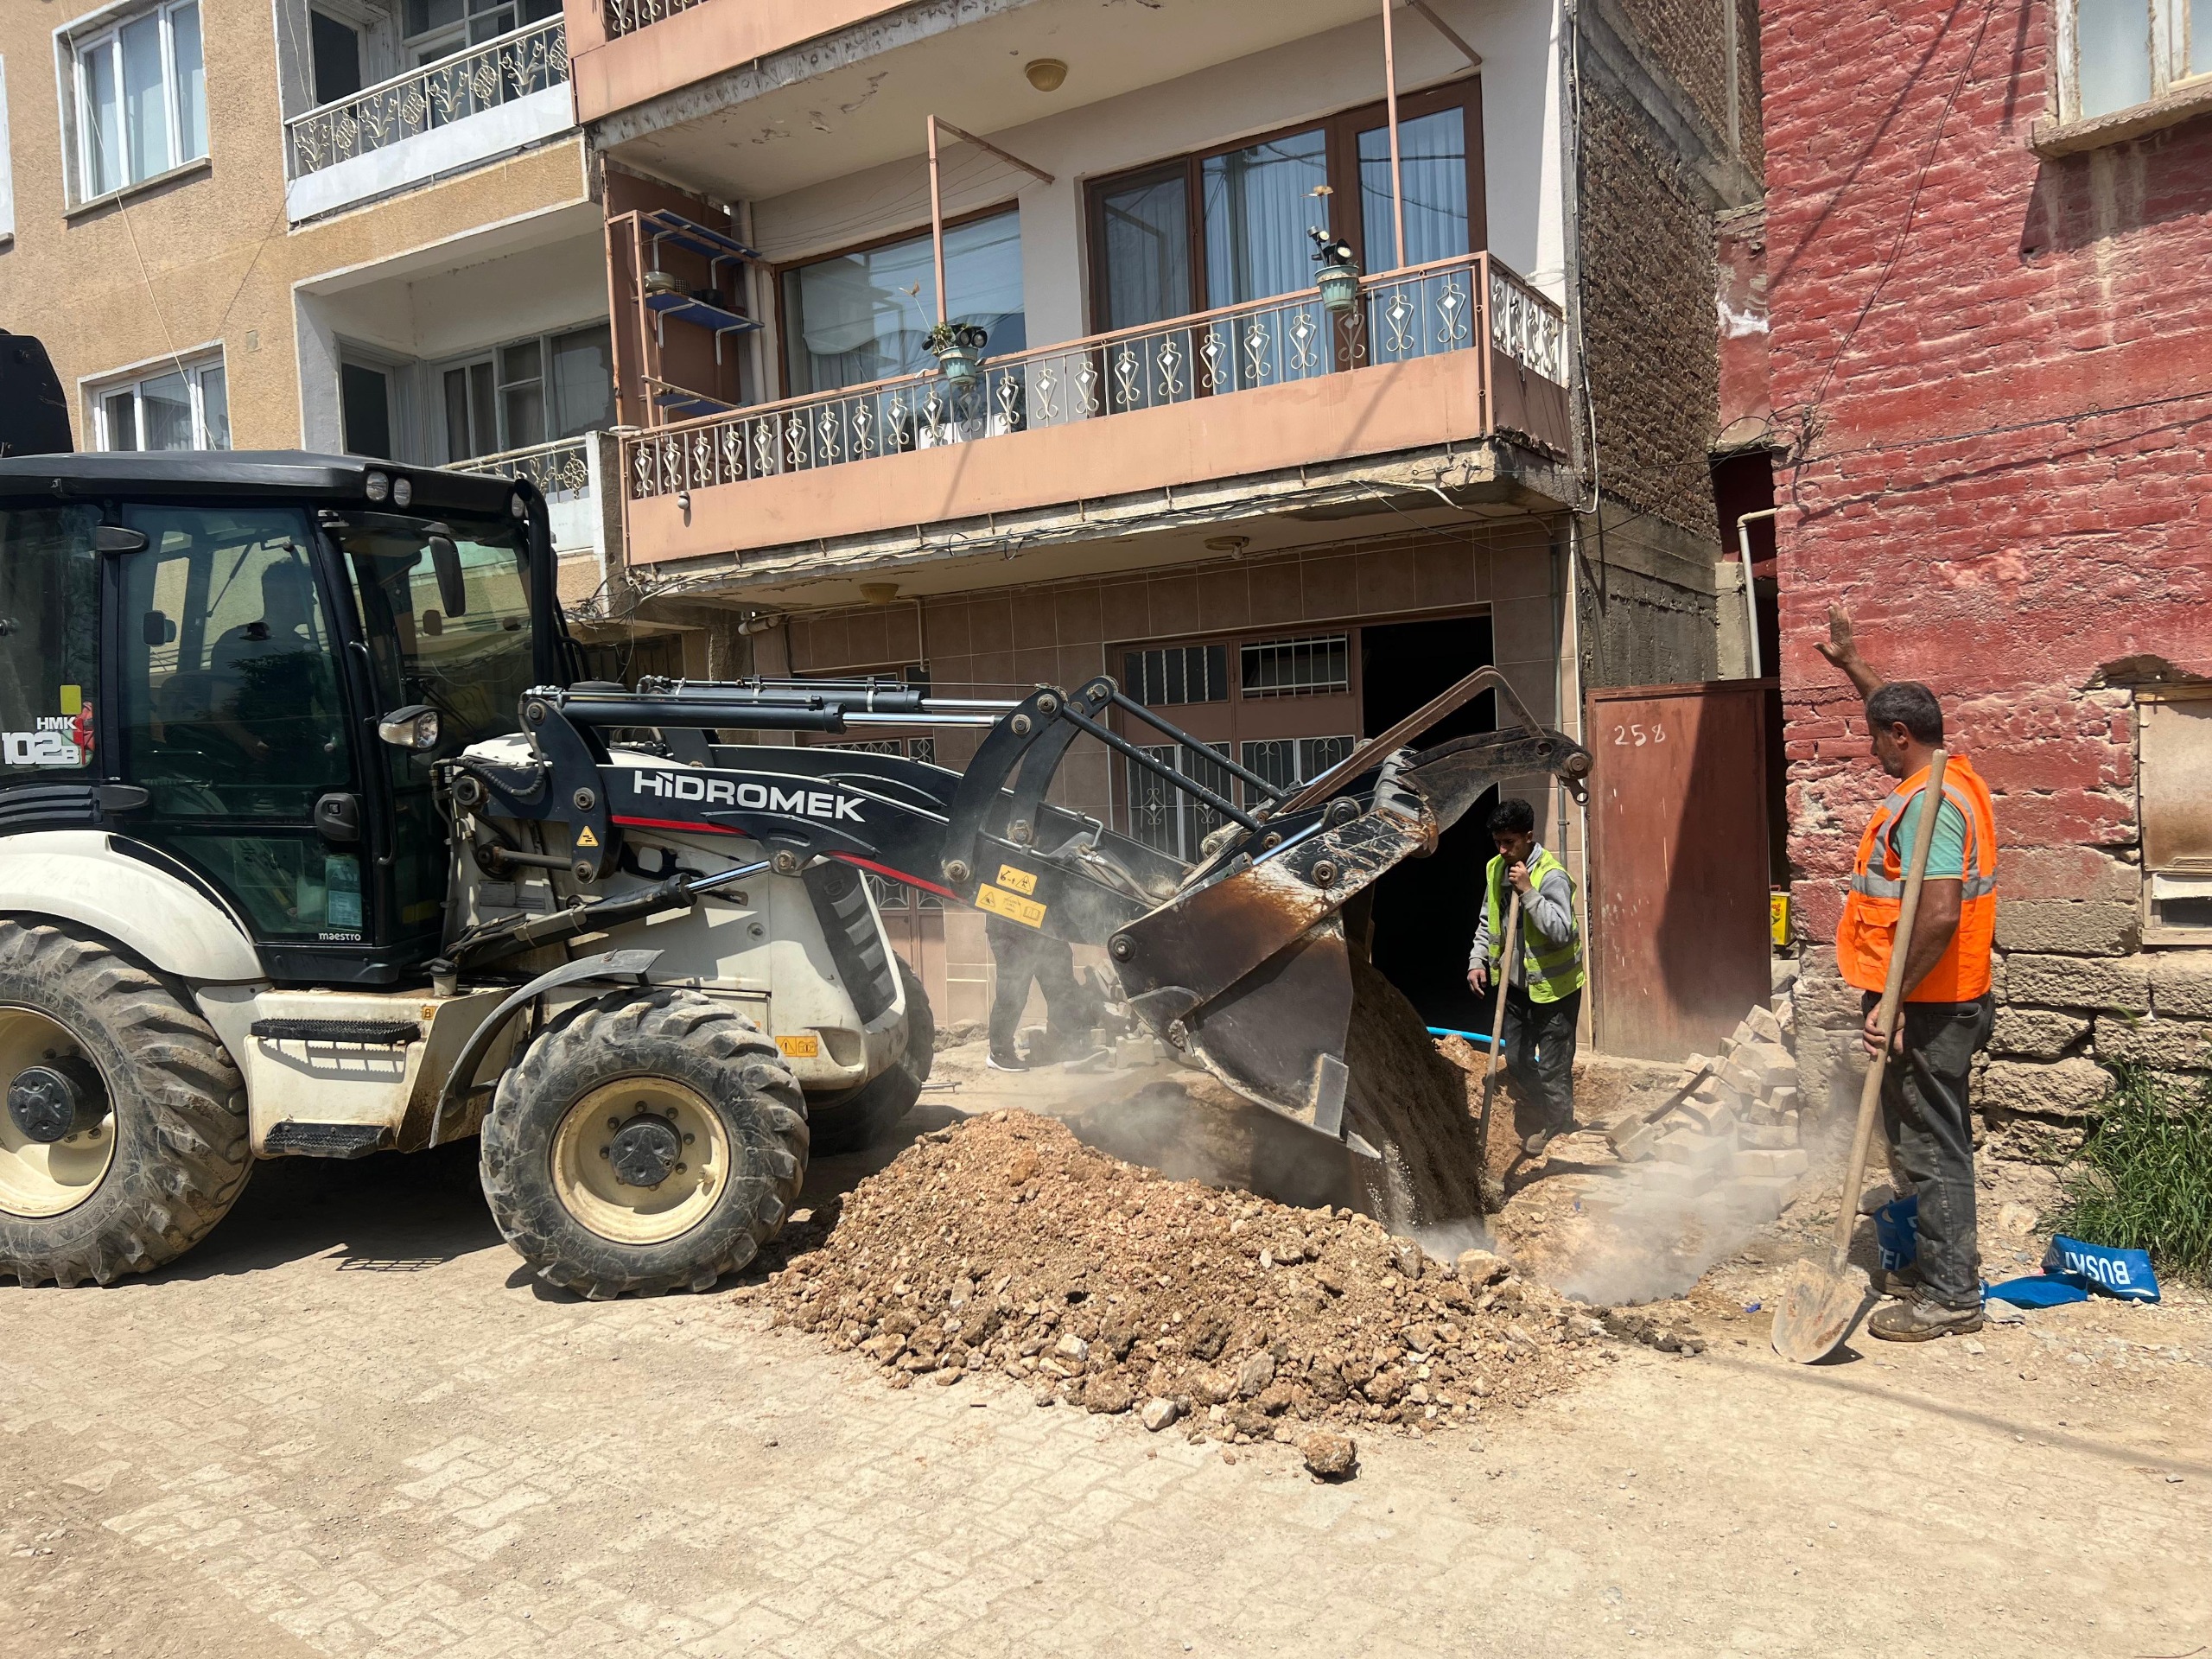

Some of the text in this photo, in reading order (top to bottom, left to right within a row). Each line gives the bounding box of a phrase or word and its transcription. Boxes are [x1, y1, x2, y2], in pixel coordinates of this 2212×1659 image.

[36, 716, 78, 730] HMK
[1614, 723, 1666, 747] 258
[2, 732, 79, 765] 102B
[318, 932, 361, 942] maestro
